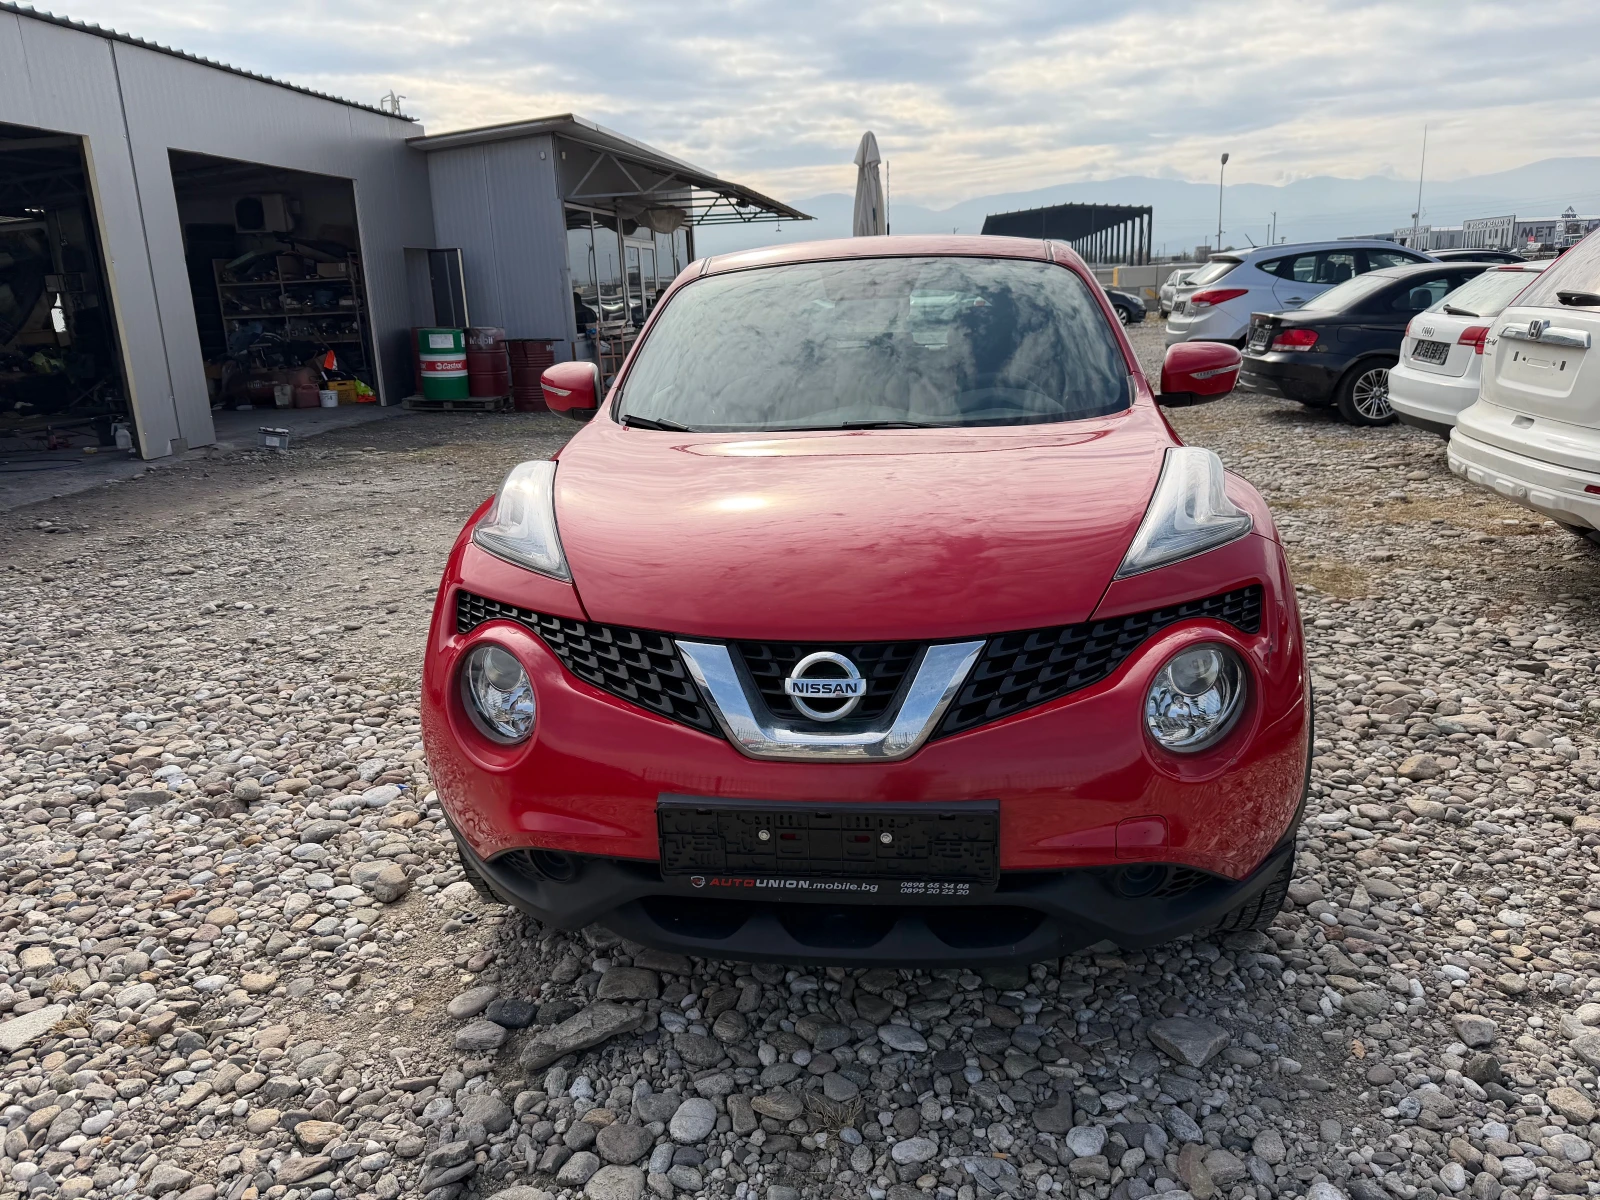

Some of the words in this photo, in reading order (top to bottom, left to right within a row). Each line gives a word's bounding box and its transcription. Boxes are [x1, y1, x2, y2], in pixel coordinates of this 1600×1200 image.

[469, 336, 493, 345] Mobil
[442, 362, 462, 370] Castrol
[792, 682, 858, 694] NISSAN
